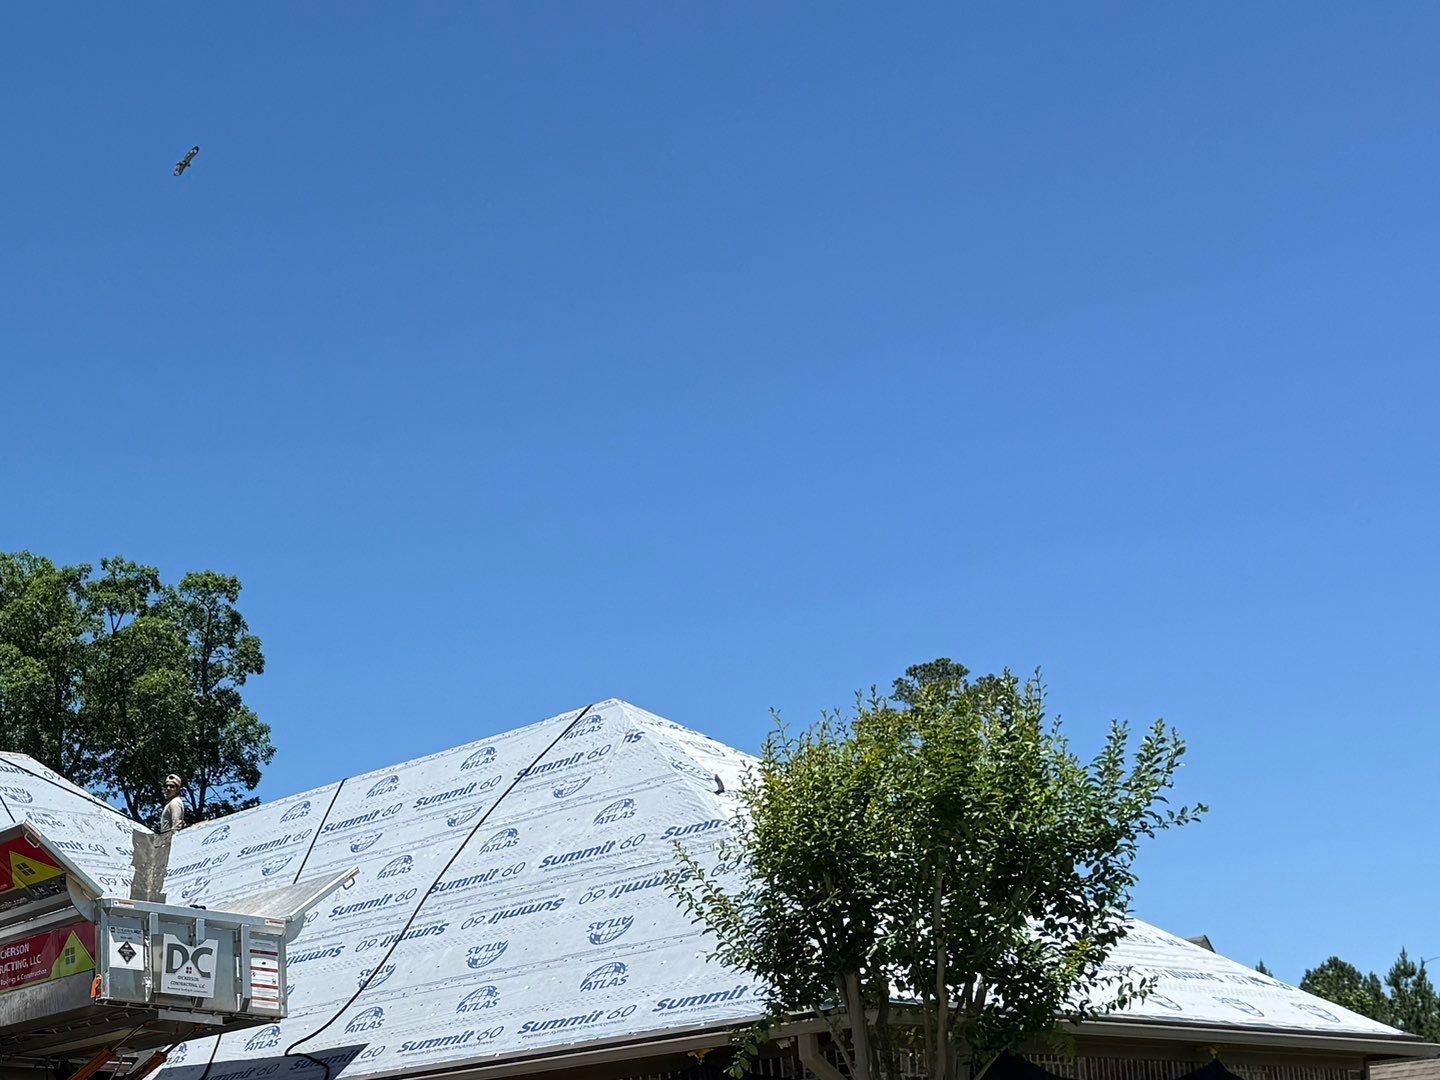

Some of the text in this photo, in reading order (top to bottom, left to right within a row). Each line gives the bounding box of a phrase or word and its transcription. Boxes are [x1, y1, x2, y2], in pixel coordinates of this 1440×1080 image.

[563, 722, 603, 741] ATLAS
[461, 755, 496, 772] ATLAS
[515, 744, 612, 780] Summit 60
[366, 784, 400, 800] ATLAS
[412, 774, 502, 809] Summit 60
[280, 810, 310, 824] ATLAS
[321, 802, 403, 835] Summit 60
[593, 808, 637, 827] ATLAS
[87, 842, 110, 856] 60
[202, 833, 231, 847] ATLAS
[237, 828, 313, 858] Summit 60
[479, 838, 521, 855] ATLAS
[212, 851, 230, 865] 60
[538, 833, 647, 869] Summit 60
[376, 864, 414, 881] ATLAS
[431, 861, 527, 894] Summit 60
[329, 887, 418, 919] Summit 60
[578, 888, 606, 905] 60
[460, 897, 566, 931] Summit 60
[586, 914, 635, 933] ATLAS
[354, 922, 450, 953] Summit 60
[466, 939, 511, 956] ATLAS
[30, 954, 42, 966] LLC
[165, 942, 214, 980] DC
[580, 974, 630, 993] ATLAS
[456, 997, 501, 1014] ATLAS
[652, 984, 751, 1013] Summit
[344, 1018, 386, 1034] ATLAS
[517, 1009, 604, 1035] Summit
[606, 1004, 638, 1020] 60
[243, 1037, 281, 1052] ATLAS
[396, 1028, 474, 1053] Summit
[475, 1025, 505, 1042] 60
[359, 1045, 386, 1060] 60
[255, 1062, 279, 1077] 60
